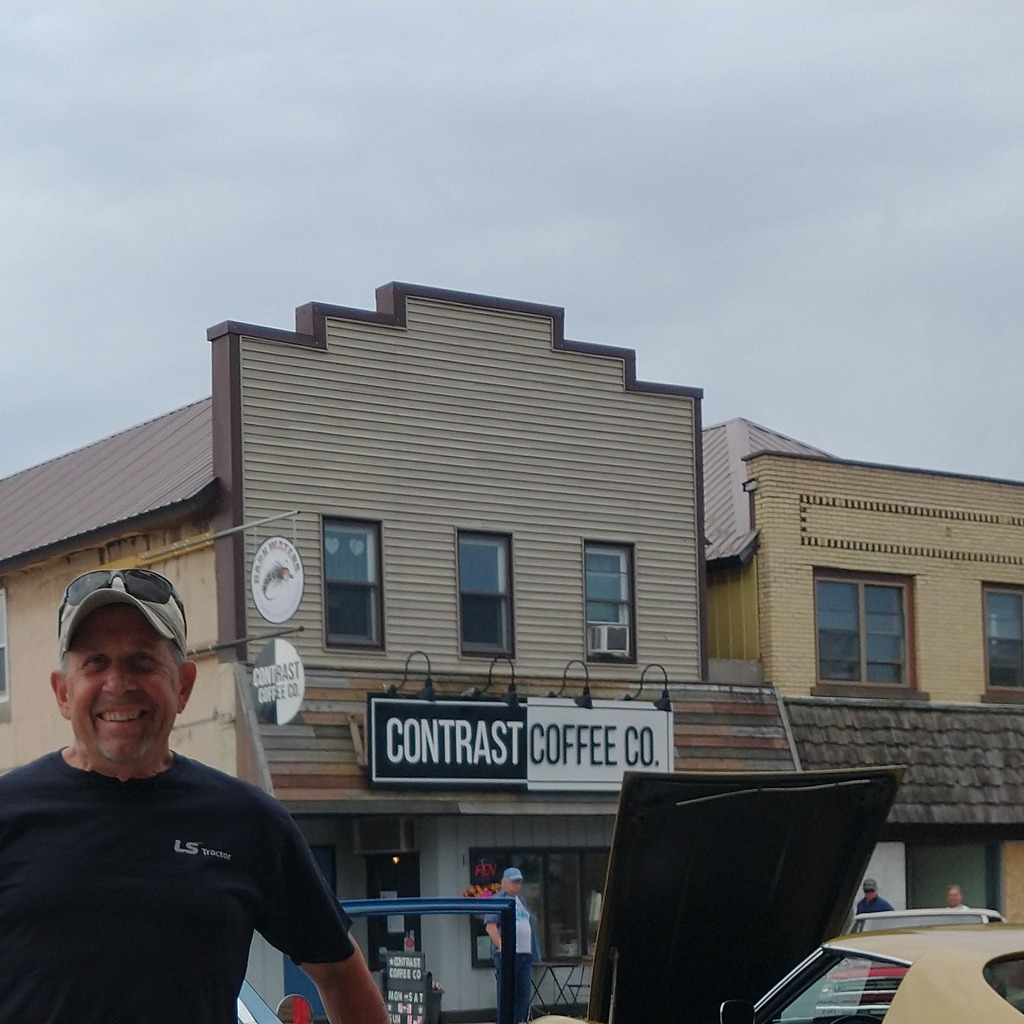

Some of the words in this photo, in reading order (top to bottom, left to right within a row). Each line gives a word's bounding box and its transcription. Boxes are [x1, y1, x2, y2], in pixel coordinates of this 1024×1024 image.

[253, 661, 300, 687] CONTRAST
[258, 684, 287, 704] COFFEE
[386, 716, 525, 767] CONTRAST
[529, 722, 617, 767] COFFEE
[625, 726, 660, 767] CO.
[174, 839, 199, 855] LS
[201, 847, 232, 860] Tractor
[393, 956, 421, 968] CONTRAST
[389, 968, 411, 979] COFFEE
